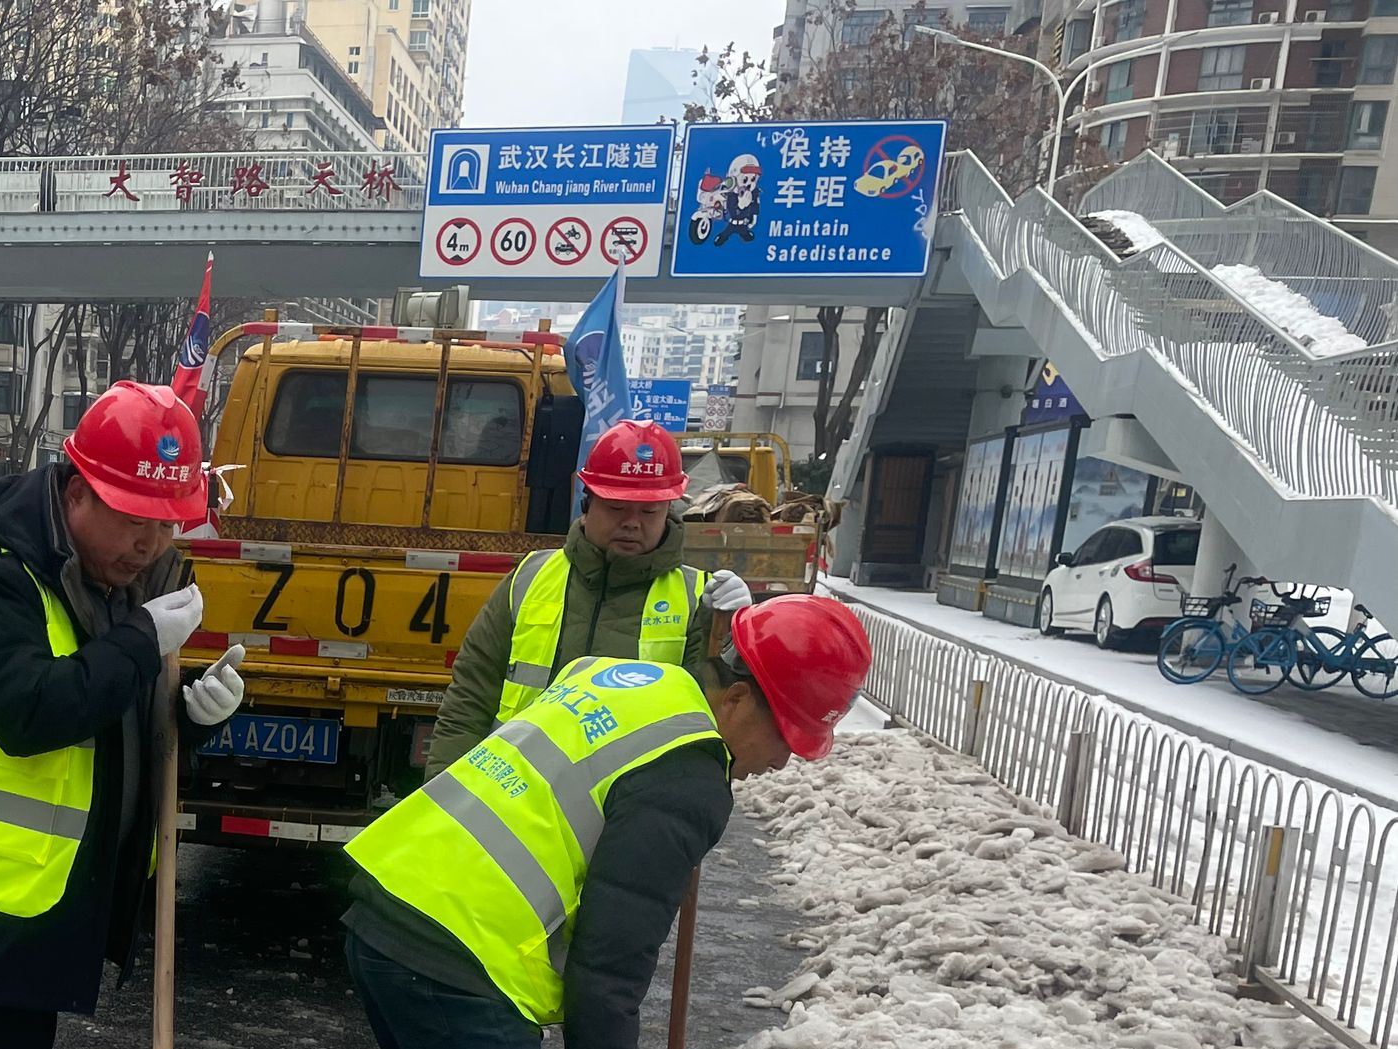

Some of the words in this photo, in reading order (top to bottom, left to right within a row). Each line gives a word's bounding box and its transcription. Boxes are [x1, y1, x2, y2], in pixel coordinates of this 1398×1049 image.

[498, 143, 659, 170] 武汉长江隧道
[779, 135, 851, 169] 保持
[103, 159, 403, 203] 大智路天桥
[495, 181, 529, 194] Wuhan
[532, 180, 562, 197] Chang
[565, 180, 590, 197] jiang
[593, 180, 619, 194] River
[622, 179, 656, 193] Tunnel
[773, 175, 847, 209] 车距
[768, 219, 850, 238] Maintain
[500, 230, 527, 252] 60
[766, 245, 891, 262] Safedistance
[136, 460, 191, 483] 武水工程
[620, 462, 664, 477] 武水工程
